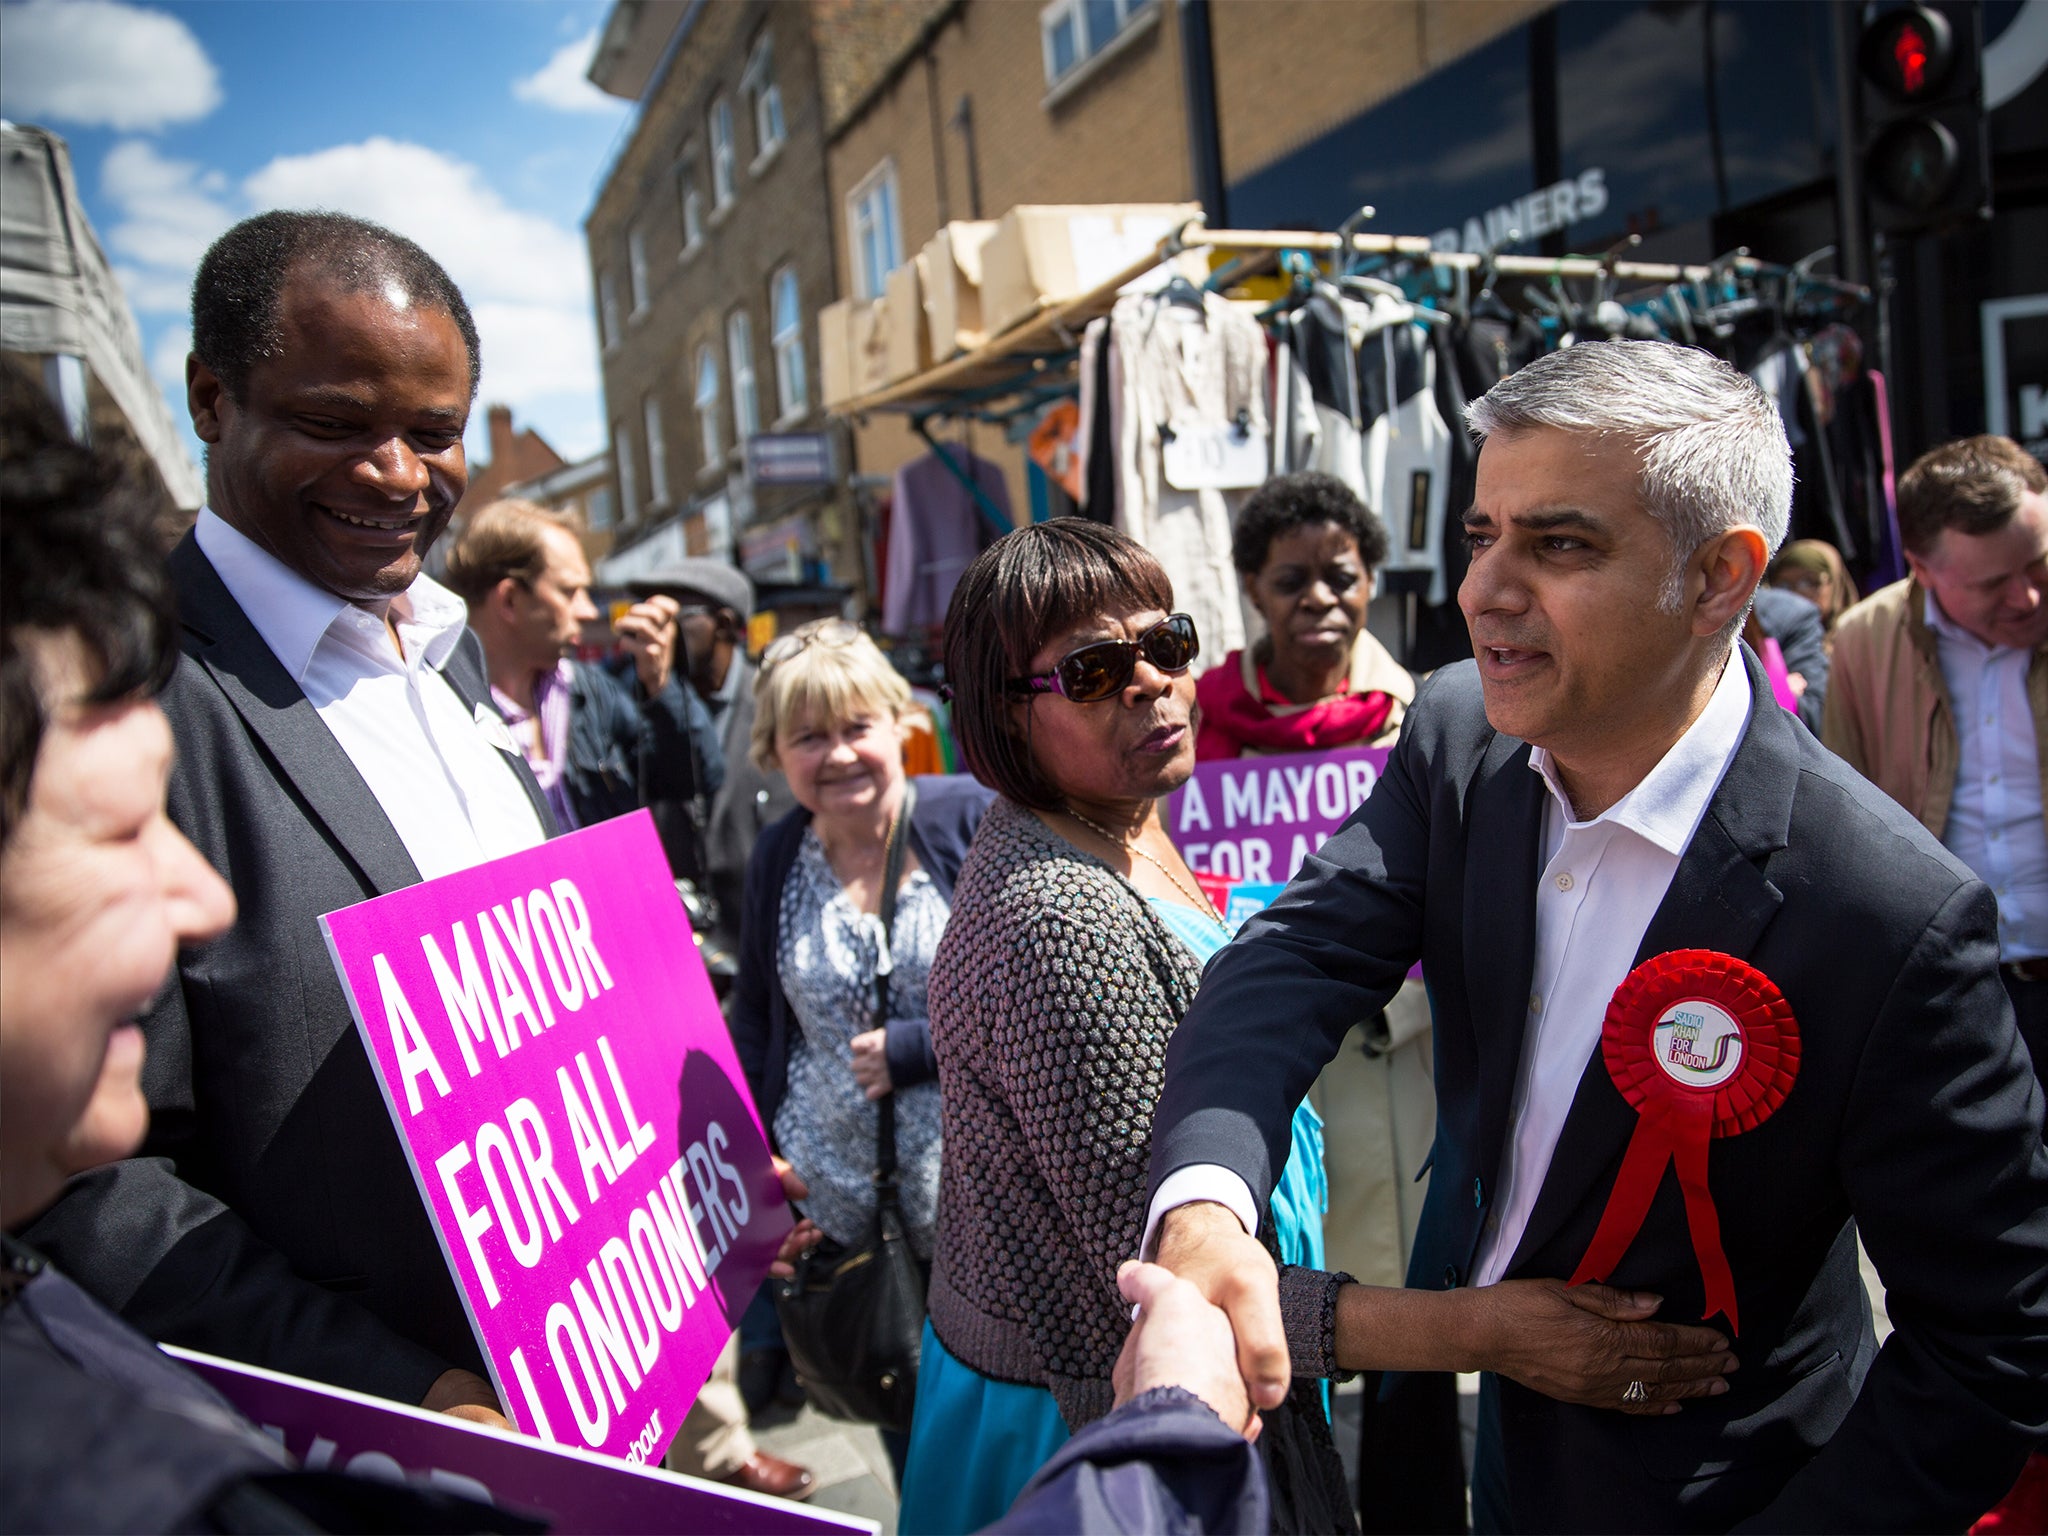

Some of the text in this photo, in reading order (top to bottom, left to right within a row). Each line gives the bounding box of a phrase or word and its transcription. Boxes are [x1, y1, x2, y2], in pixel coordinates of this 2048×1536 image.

[1430, 166, 1609, 254] RAINERS
[1179, 759, 1377, 833] A MAYOR
[1184, 837, 1273, 886] FOR
[372, 878, 614, 1117] A MAYOR
[1673, 1024, 1699, 1041] KHAN
[1668, 1050, 1707, 1069] LONDON
[1671, 1037, 1690, 1052] FOR
[434, 1035, 657, 1310] FOR ALL
[509, 1121, 750, 1449] LONDONERS
